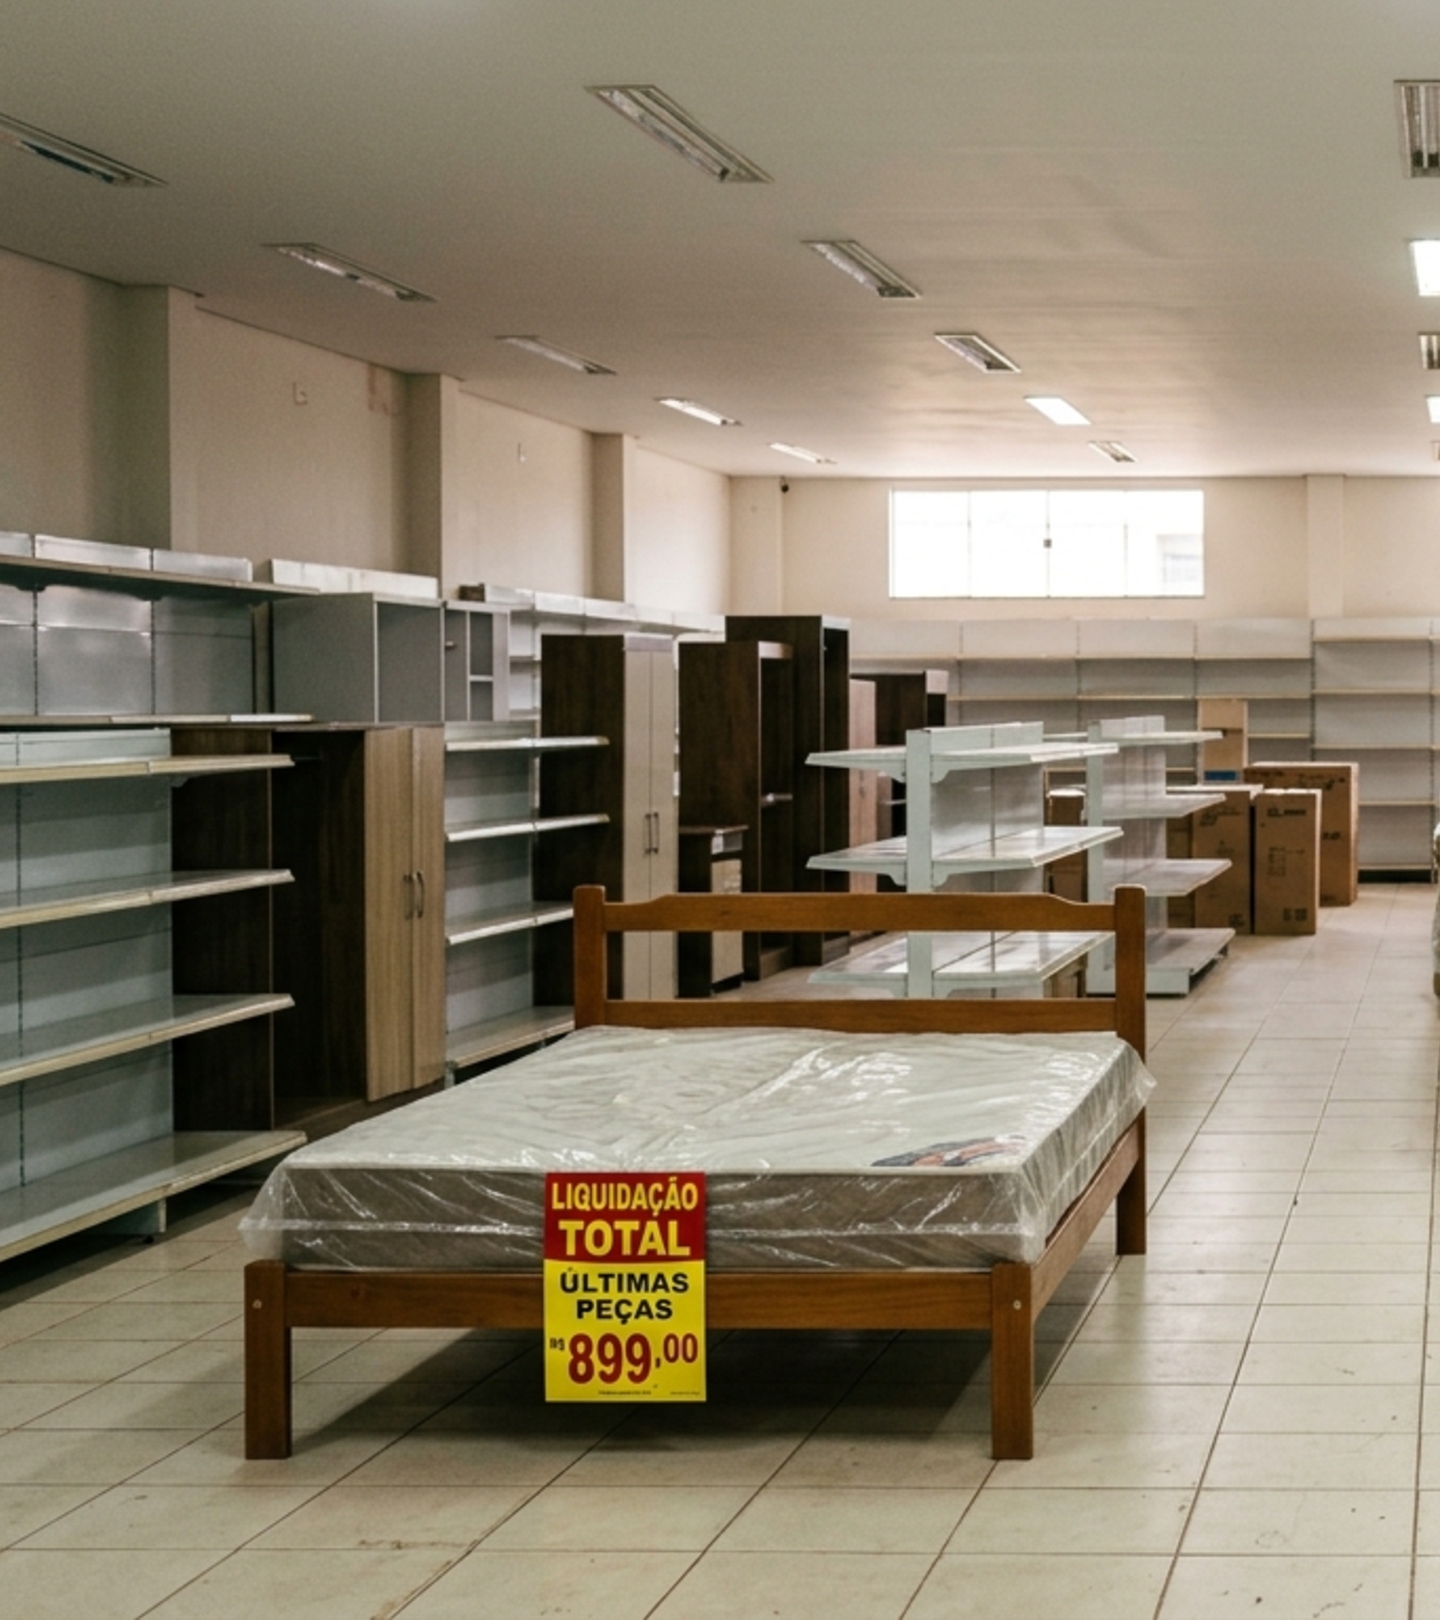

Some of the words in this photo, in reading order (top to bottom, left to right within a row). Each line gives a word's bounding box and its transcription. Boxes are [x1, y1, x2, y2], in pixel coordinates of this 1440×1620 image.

[551, 1176, 699, 1217] LIQUIDAÇÃO
[558, 1219, 691, 1256] TOTAL
[560, 1267, 690, 1293] ÚLTIMAS
[576, 1299, 673, 1325] PEÇAS
[568, 1332, 699, 1384] 899,00
